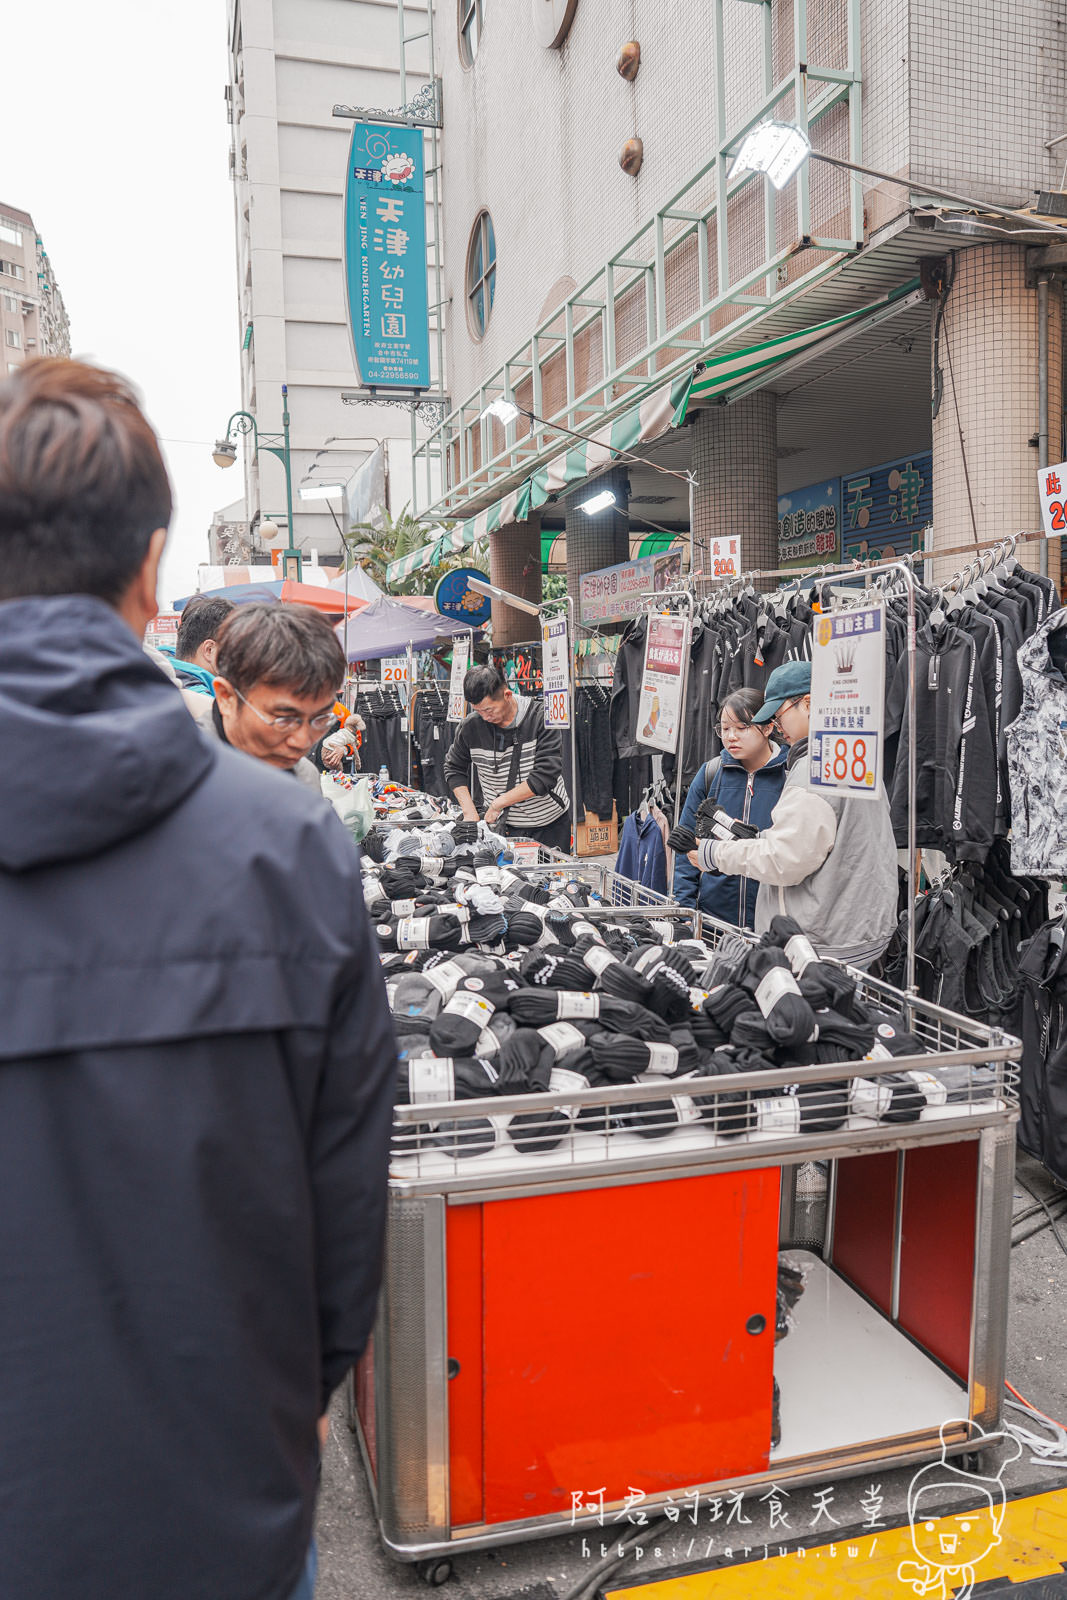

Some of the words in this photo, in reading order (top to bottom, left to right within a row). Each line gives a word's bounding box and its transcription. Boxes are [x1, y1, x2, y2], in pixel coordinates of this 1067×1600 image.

[359, 224, 369, 249] JING
[374, 197, 410, 338] 天津幼兒園
[361, 256, 371, 337] KINDERGARTEN
[847, 463, 924, 528] 天津
[1045, 471, 1062, 497] 此
[714, 558, 734, 577] 200
[994, 658, 1003, 683] ALBERT
[965, 684, 974, 710] ALBERT
[953, 794, 963, 821] ALBERT
